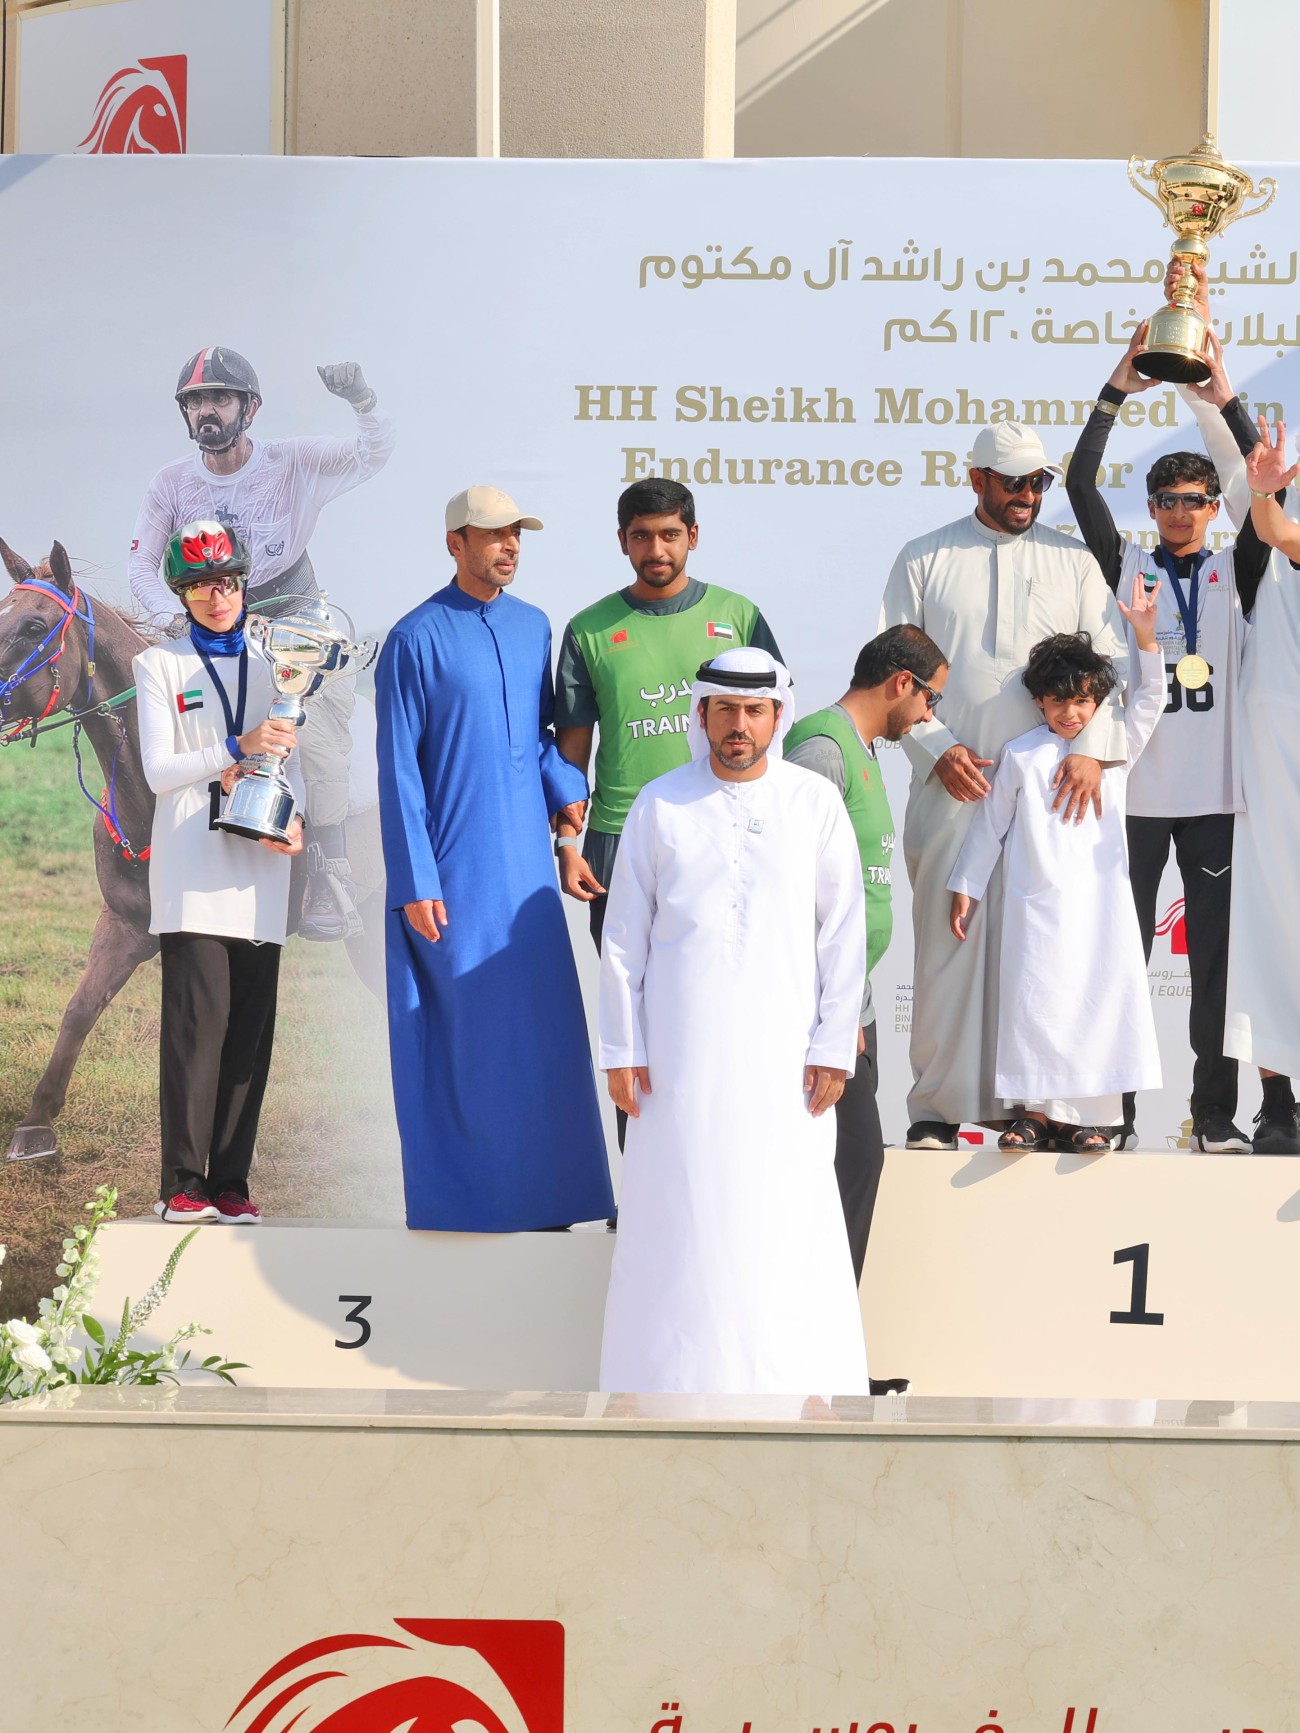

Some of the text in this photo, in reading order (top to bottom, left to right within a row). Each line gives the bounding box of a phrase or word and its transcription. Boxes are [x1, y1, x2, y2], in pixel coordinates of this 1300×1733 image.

[638, 244, 792, 290] مكتوم
[804, 238, 853, 291] آل
[861, 239, 964, 292] راشد
[974, 256, 1031, 294] بن
[1045, 256, 1165, 287] محمد
[883, 308, 956, 352] كم
[574, 384, 658, 421] HH
[675, 384, 857, 424] Sheikh
[620, 447, 904, 487] Endurance
[920, 450, 975, 488] Ri
[639, 677, 693, 708] درب
[895, 1004, 910, 1013] HH
[1109, 1242, 1165, 1327] 1
[334, 1294, 373, 1350] 3
